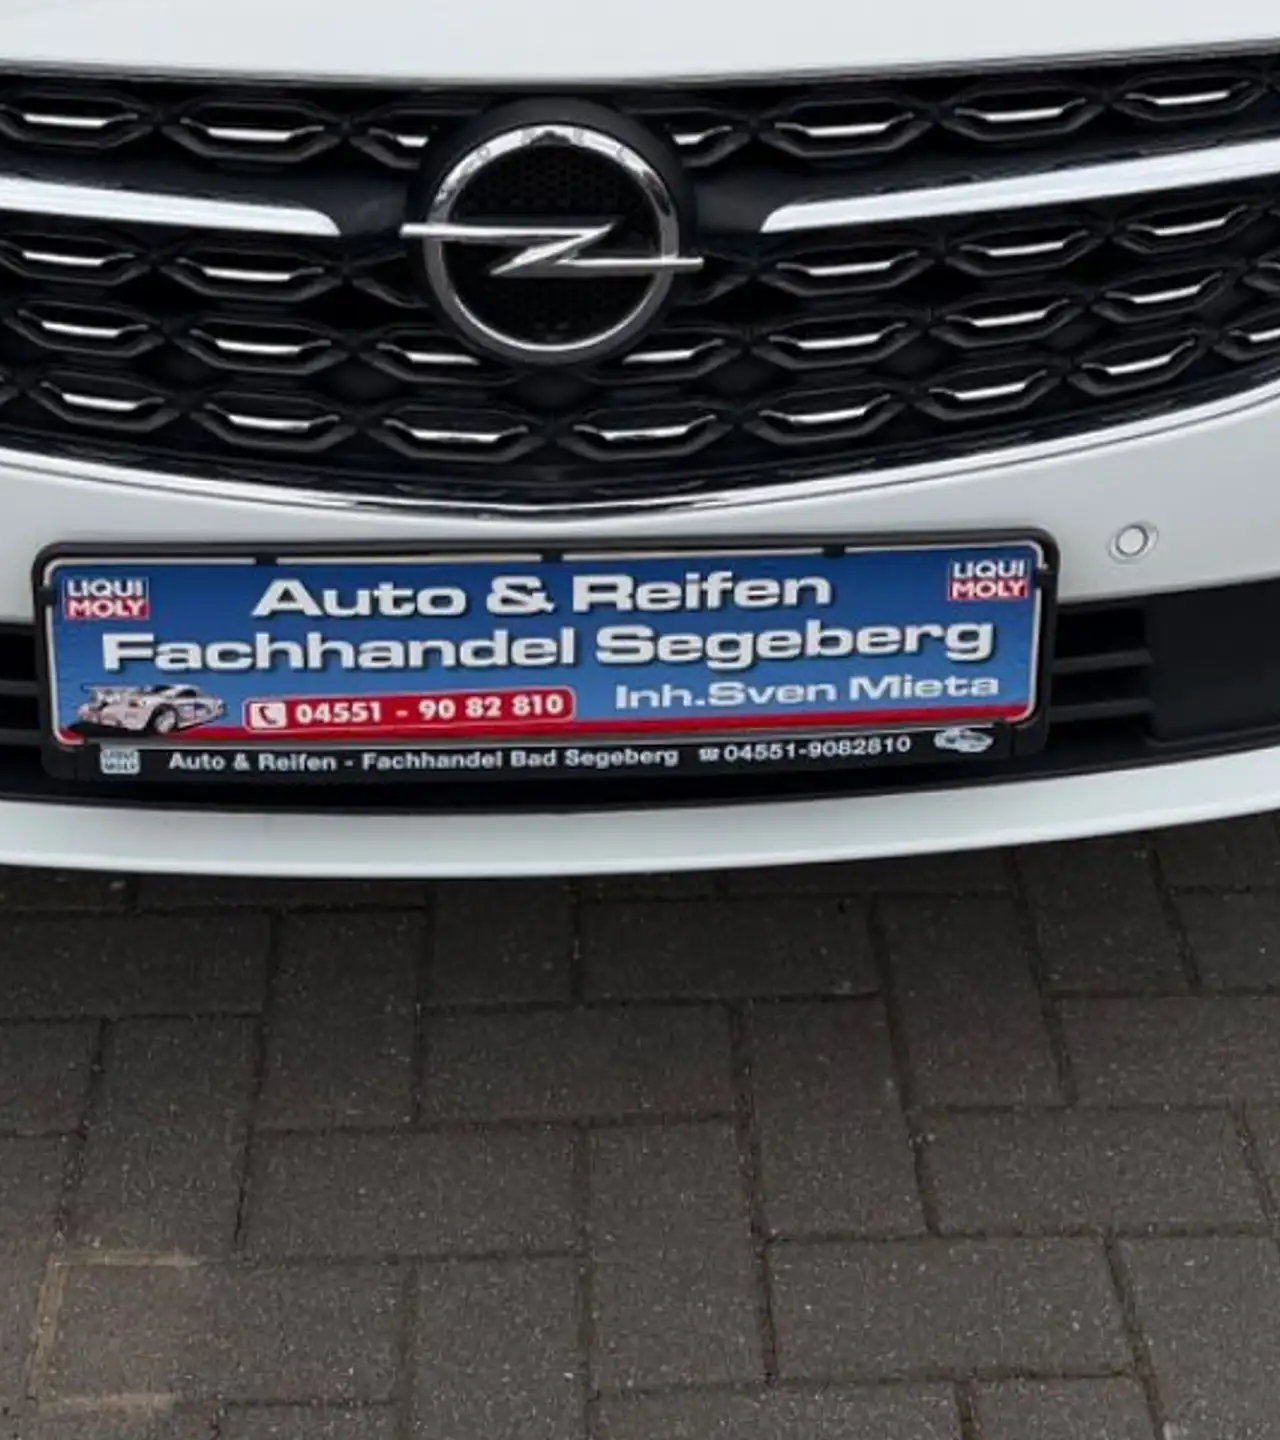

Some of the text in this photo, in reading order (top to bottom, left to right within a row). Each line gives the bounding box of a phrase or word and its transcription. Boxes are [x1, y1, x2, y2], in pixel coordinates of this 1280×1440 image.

[952, 561, 1025, 579] LIQUI
[67, 579, 144, 597] LIQUI
[251, 571, 833, 617] Auto & Reifen
[951, 579, 1026, 600] MOLY
[69, 599, 147, 617] MOLY
[102, 620, 995, 671] Fachhandel Segeberg
[848, 674, 999, 700] Mieta
[295, 702, 381, 725] 04551
[418, 699, 456, 721] 90
[465, 697, 502, 718] 82
[511, 694, 563, 716] 810
[169, 751, 226, 770] Auto
[233, 752, 251, 771] &
[258, 752, 338, 771] Reifen
[361, 750, 503, 770] Fachhandel
[510, 749, 556, 768] Bad
[564, 747, 680, 770] Segeberg
[723, 736, 912, 762] 04551-9082810
